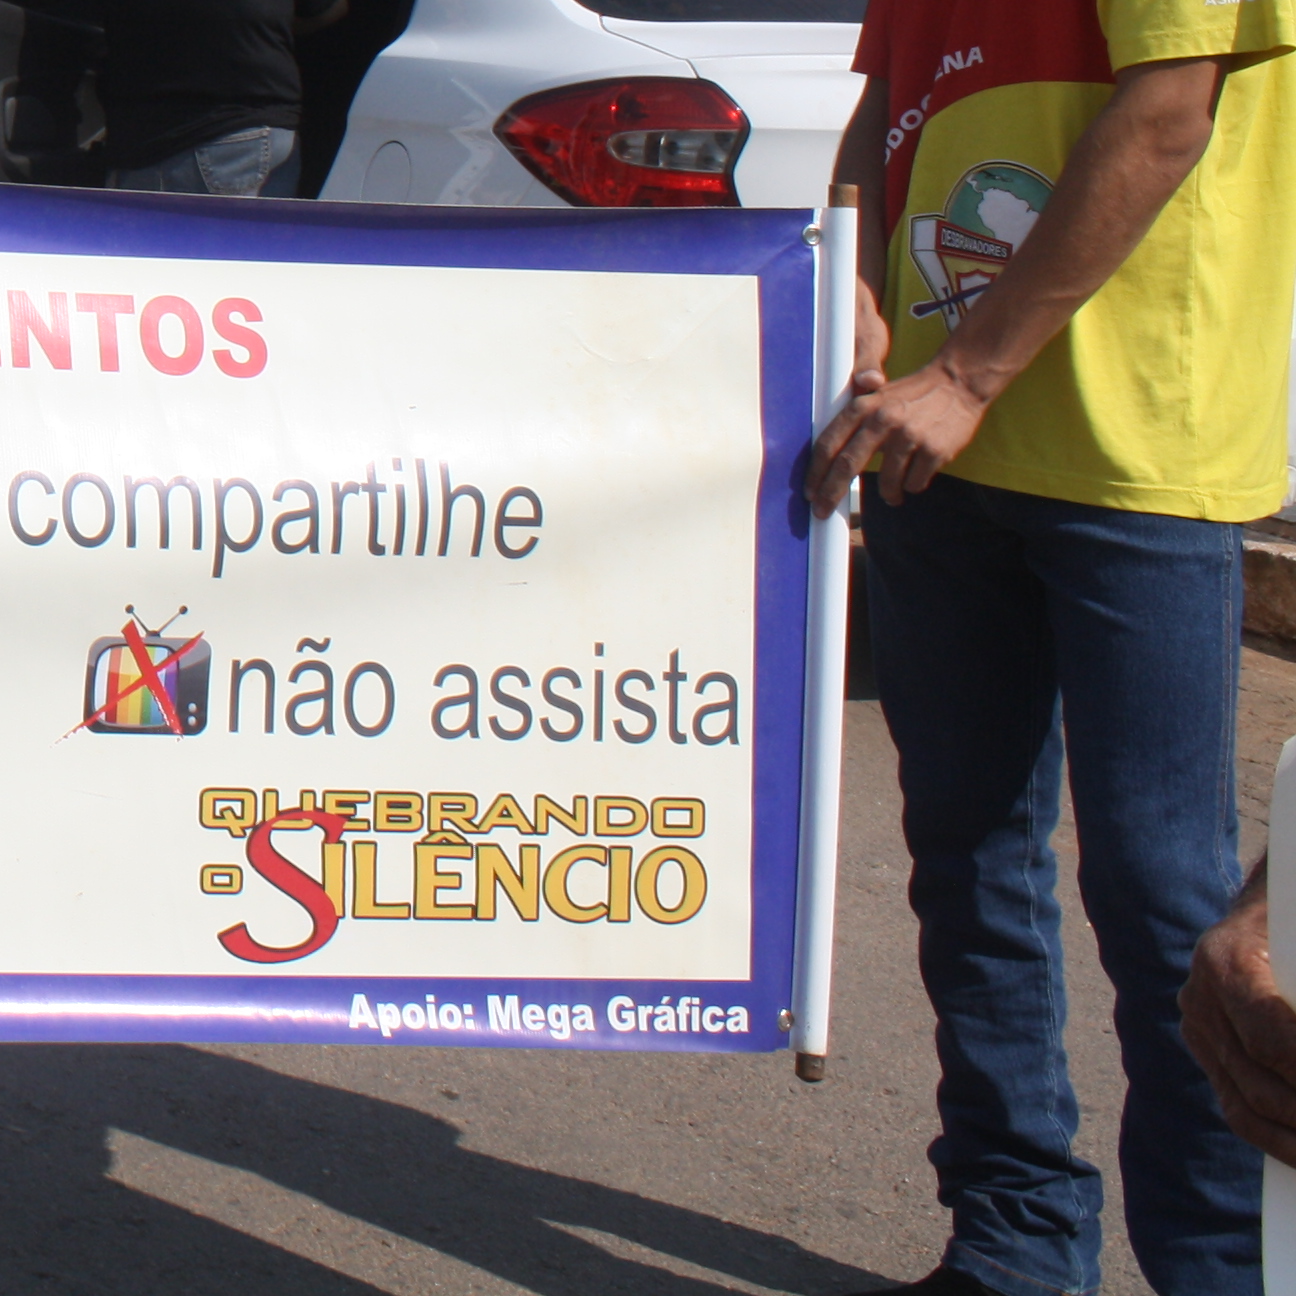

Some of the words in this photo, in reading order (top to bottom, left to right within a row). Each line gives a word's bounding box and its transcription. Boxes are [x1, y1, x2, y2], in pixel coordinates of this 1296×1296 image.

[8, 456, 544, 578] compartilhe
[227, 637, 396, 737] não
[430, 642, 741, 747] assista
[199, 787, 706, 838] QUEBRANDO
[217, 808, 708, 964] SILÊNCIO
[348, 993, 476, 1038] Apoio:
[487, 994, 596, 1040] Mega
[607, 995, 750, 1034] Gráfica
